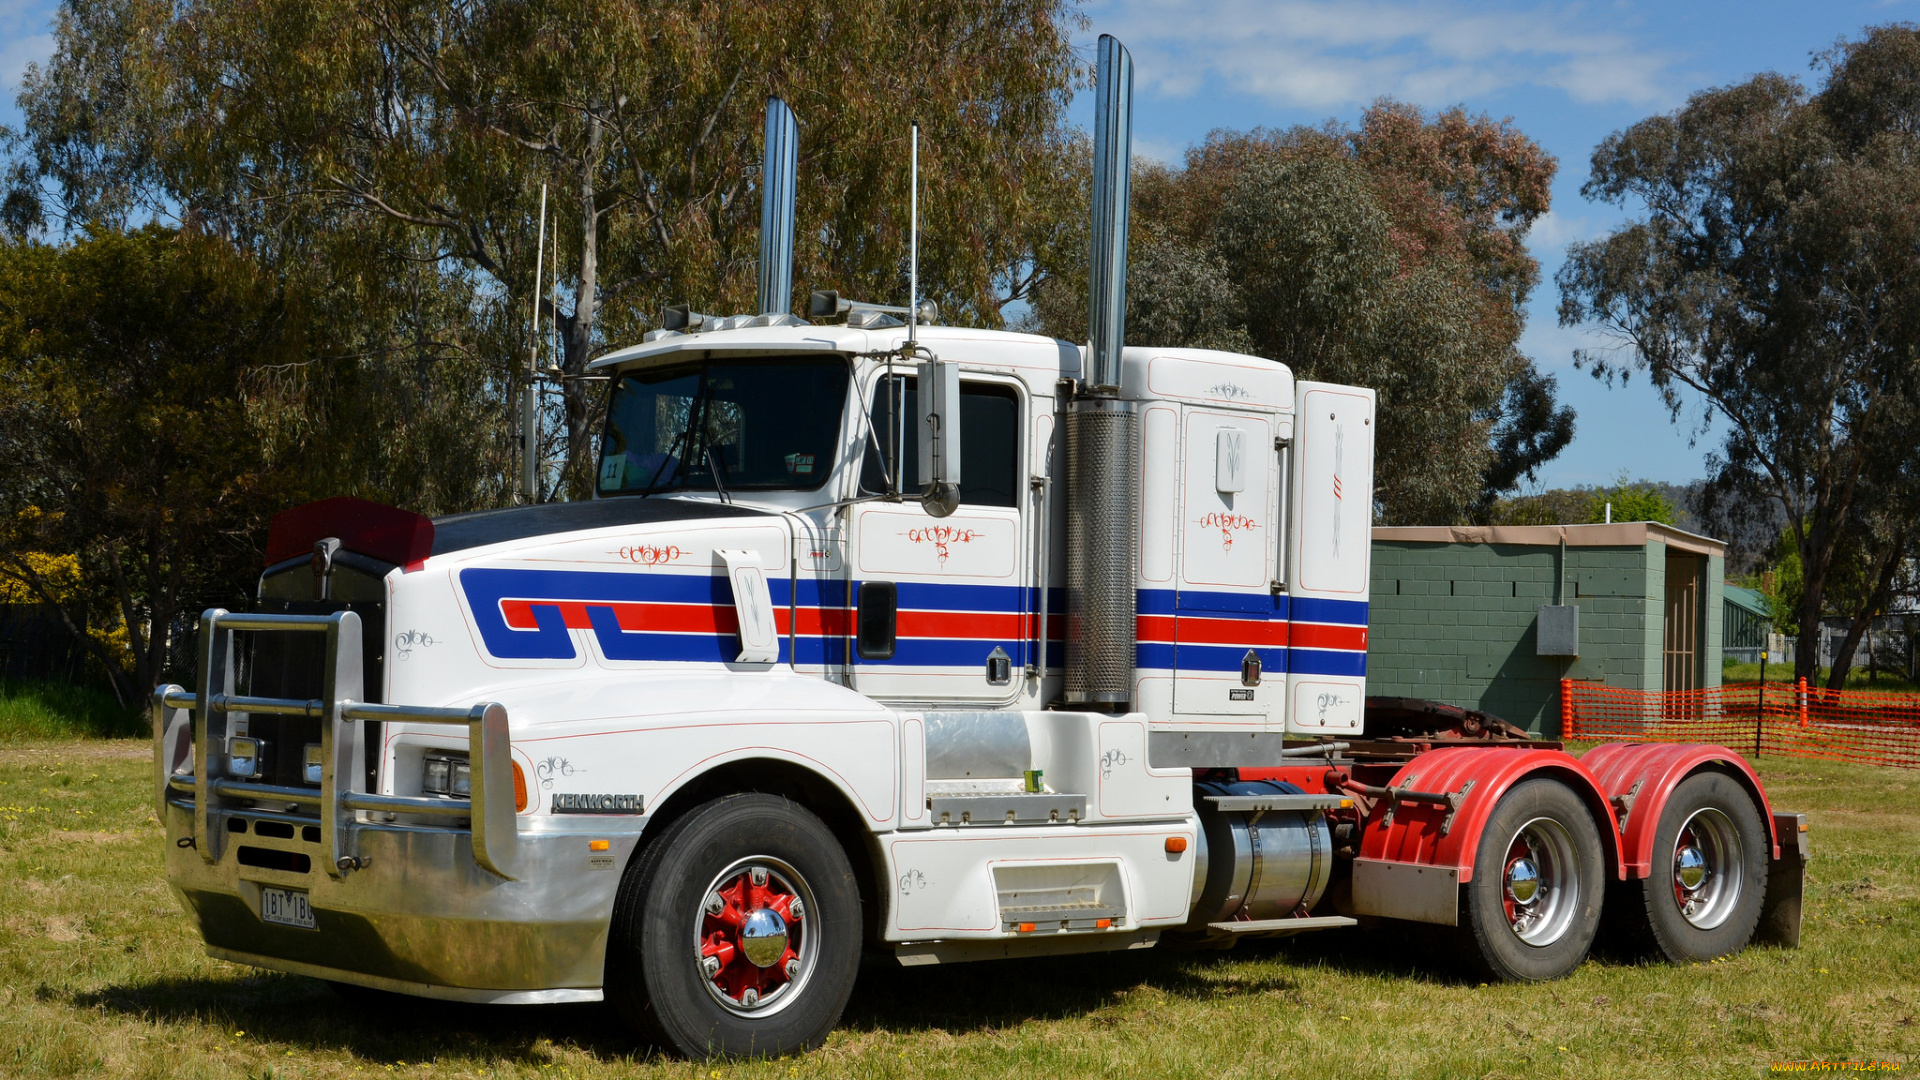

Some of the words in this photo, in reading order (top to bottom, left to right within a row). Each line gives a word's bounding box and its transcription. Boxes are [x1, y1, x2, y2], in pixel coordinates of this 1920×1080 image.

[606, 463, 617, 478] 11
[552, 793, 644, 810] KENWORTH
[265, 892, 284, 916] 1BT
